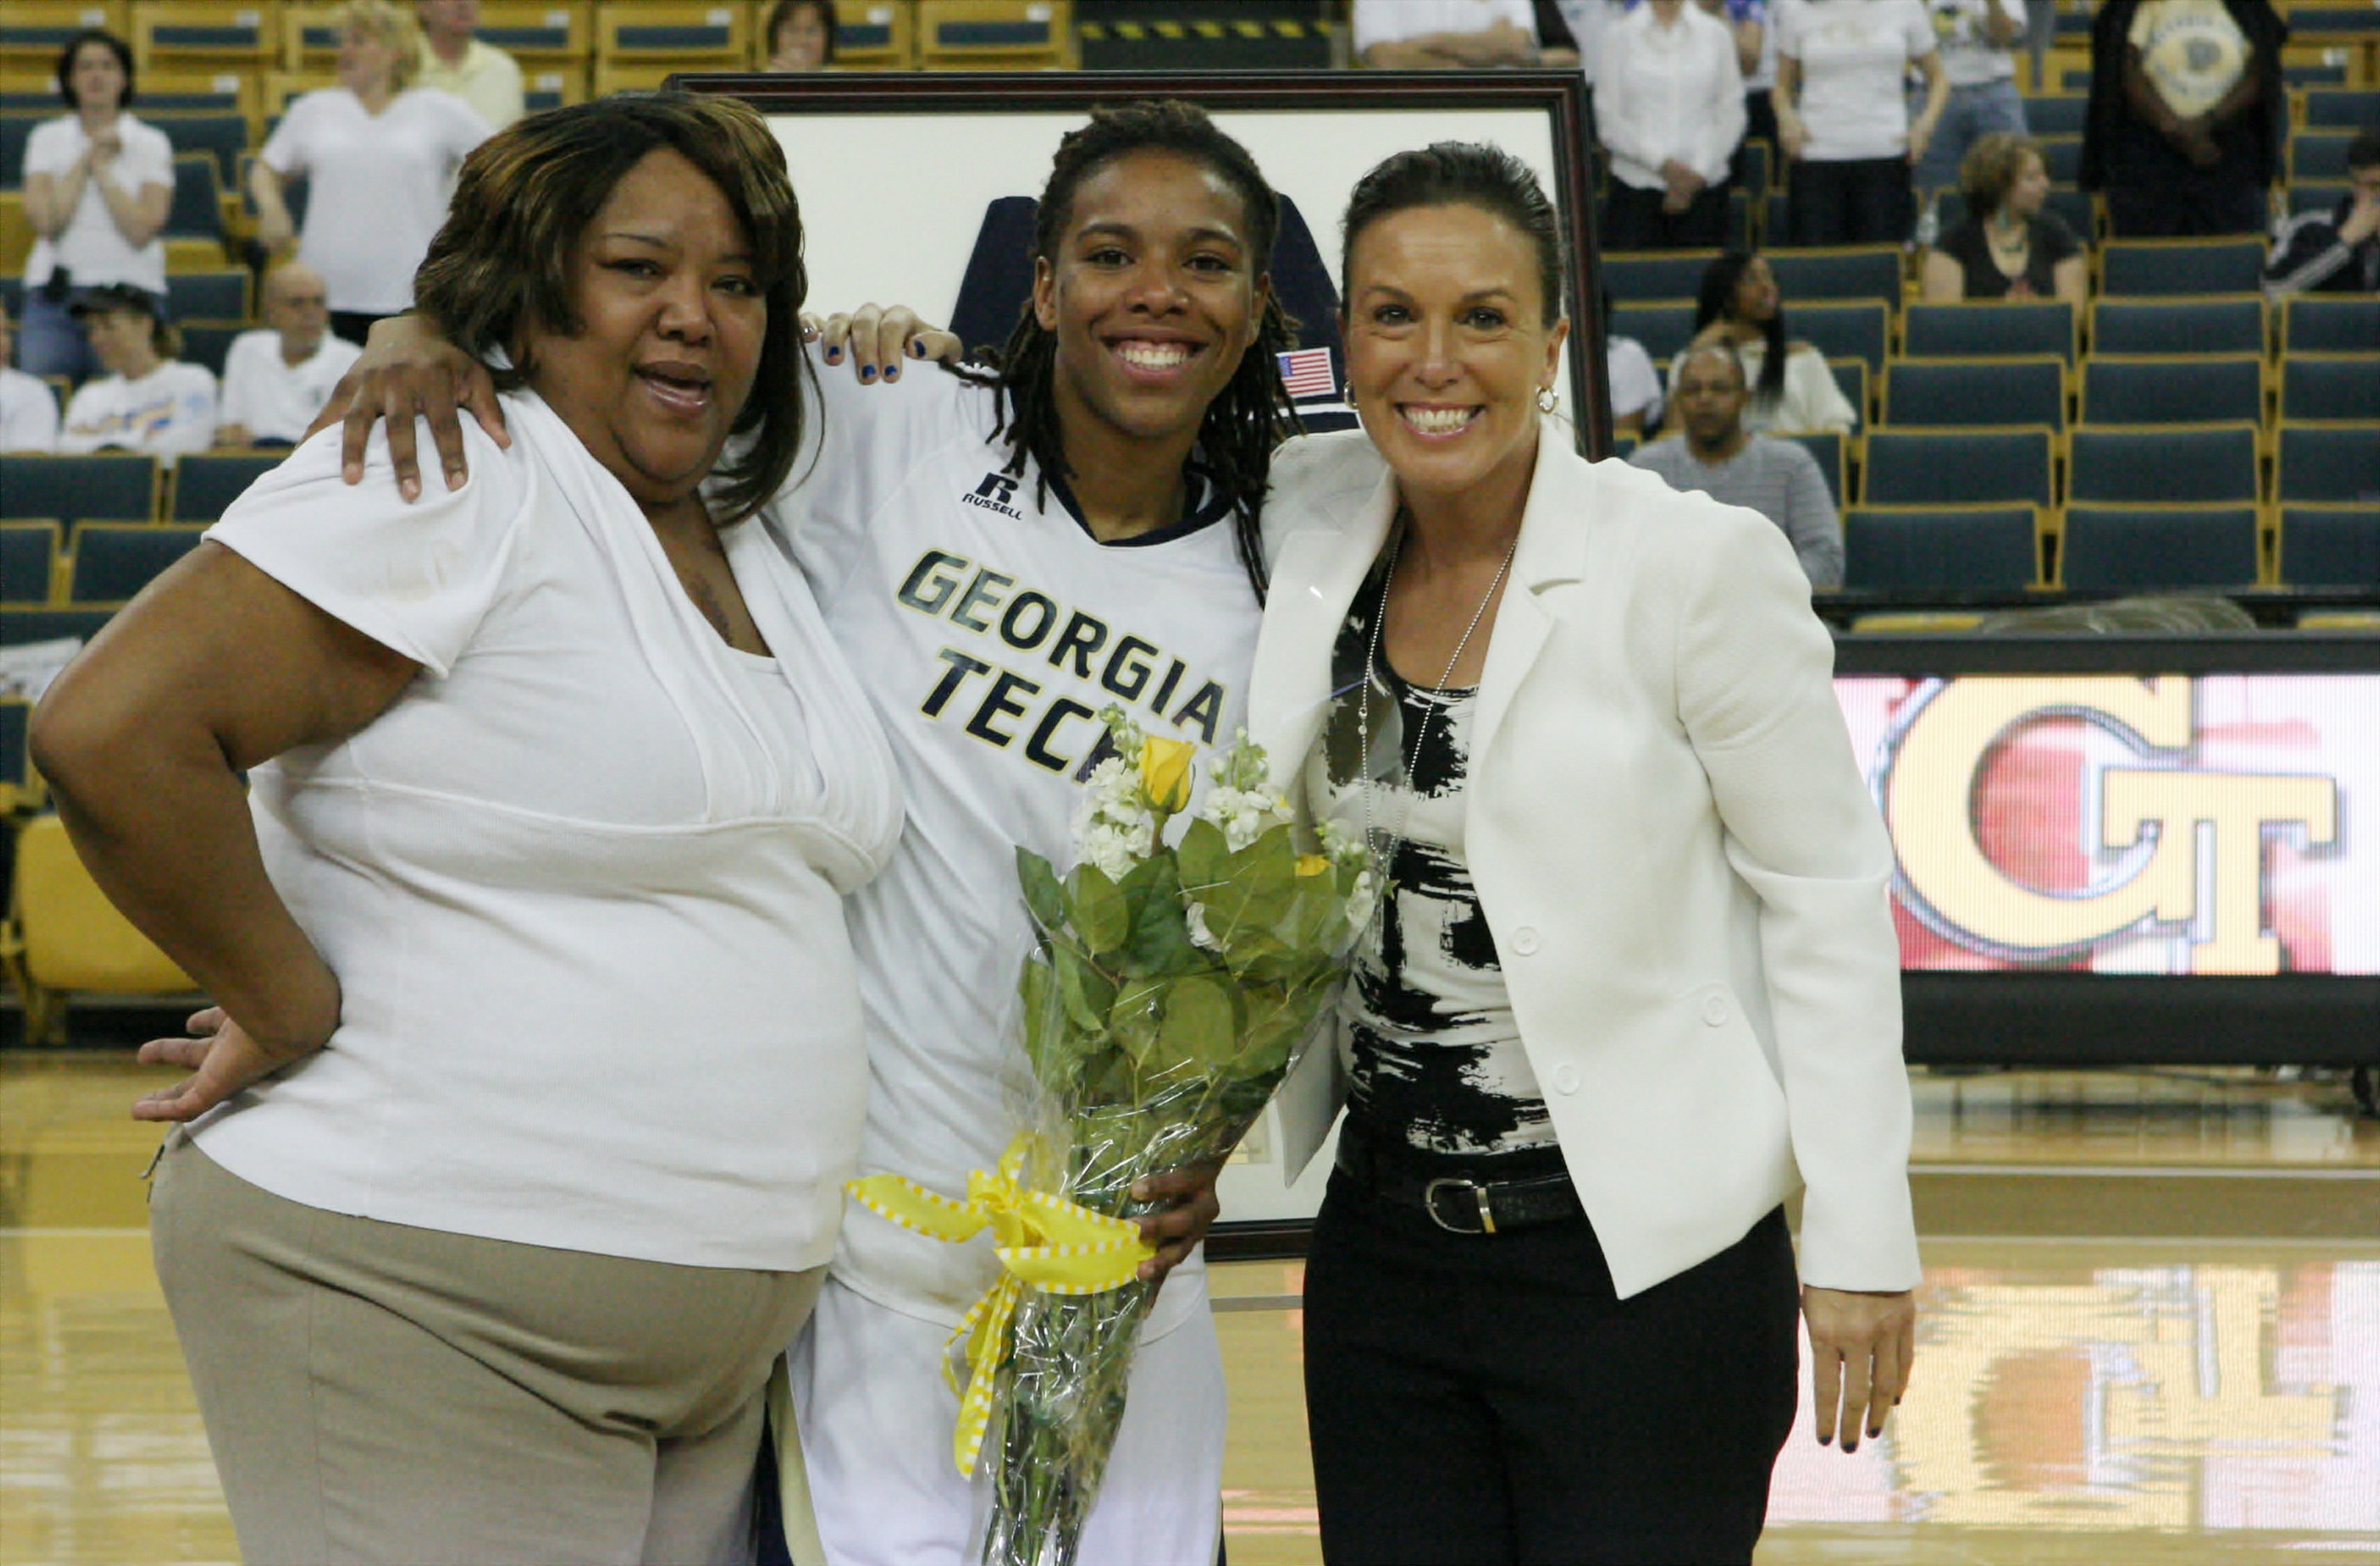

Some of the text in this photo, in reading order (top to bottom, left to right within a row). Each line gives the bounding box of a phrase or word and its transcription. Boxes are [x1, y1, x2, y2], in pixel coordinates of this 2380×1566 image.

[962, 493, 1022, 521] RUSSELL
[897, 547, 1227, 745] GEORGIA
[1887, 675, 2336, 975] GT
